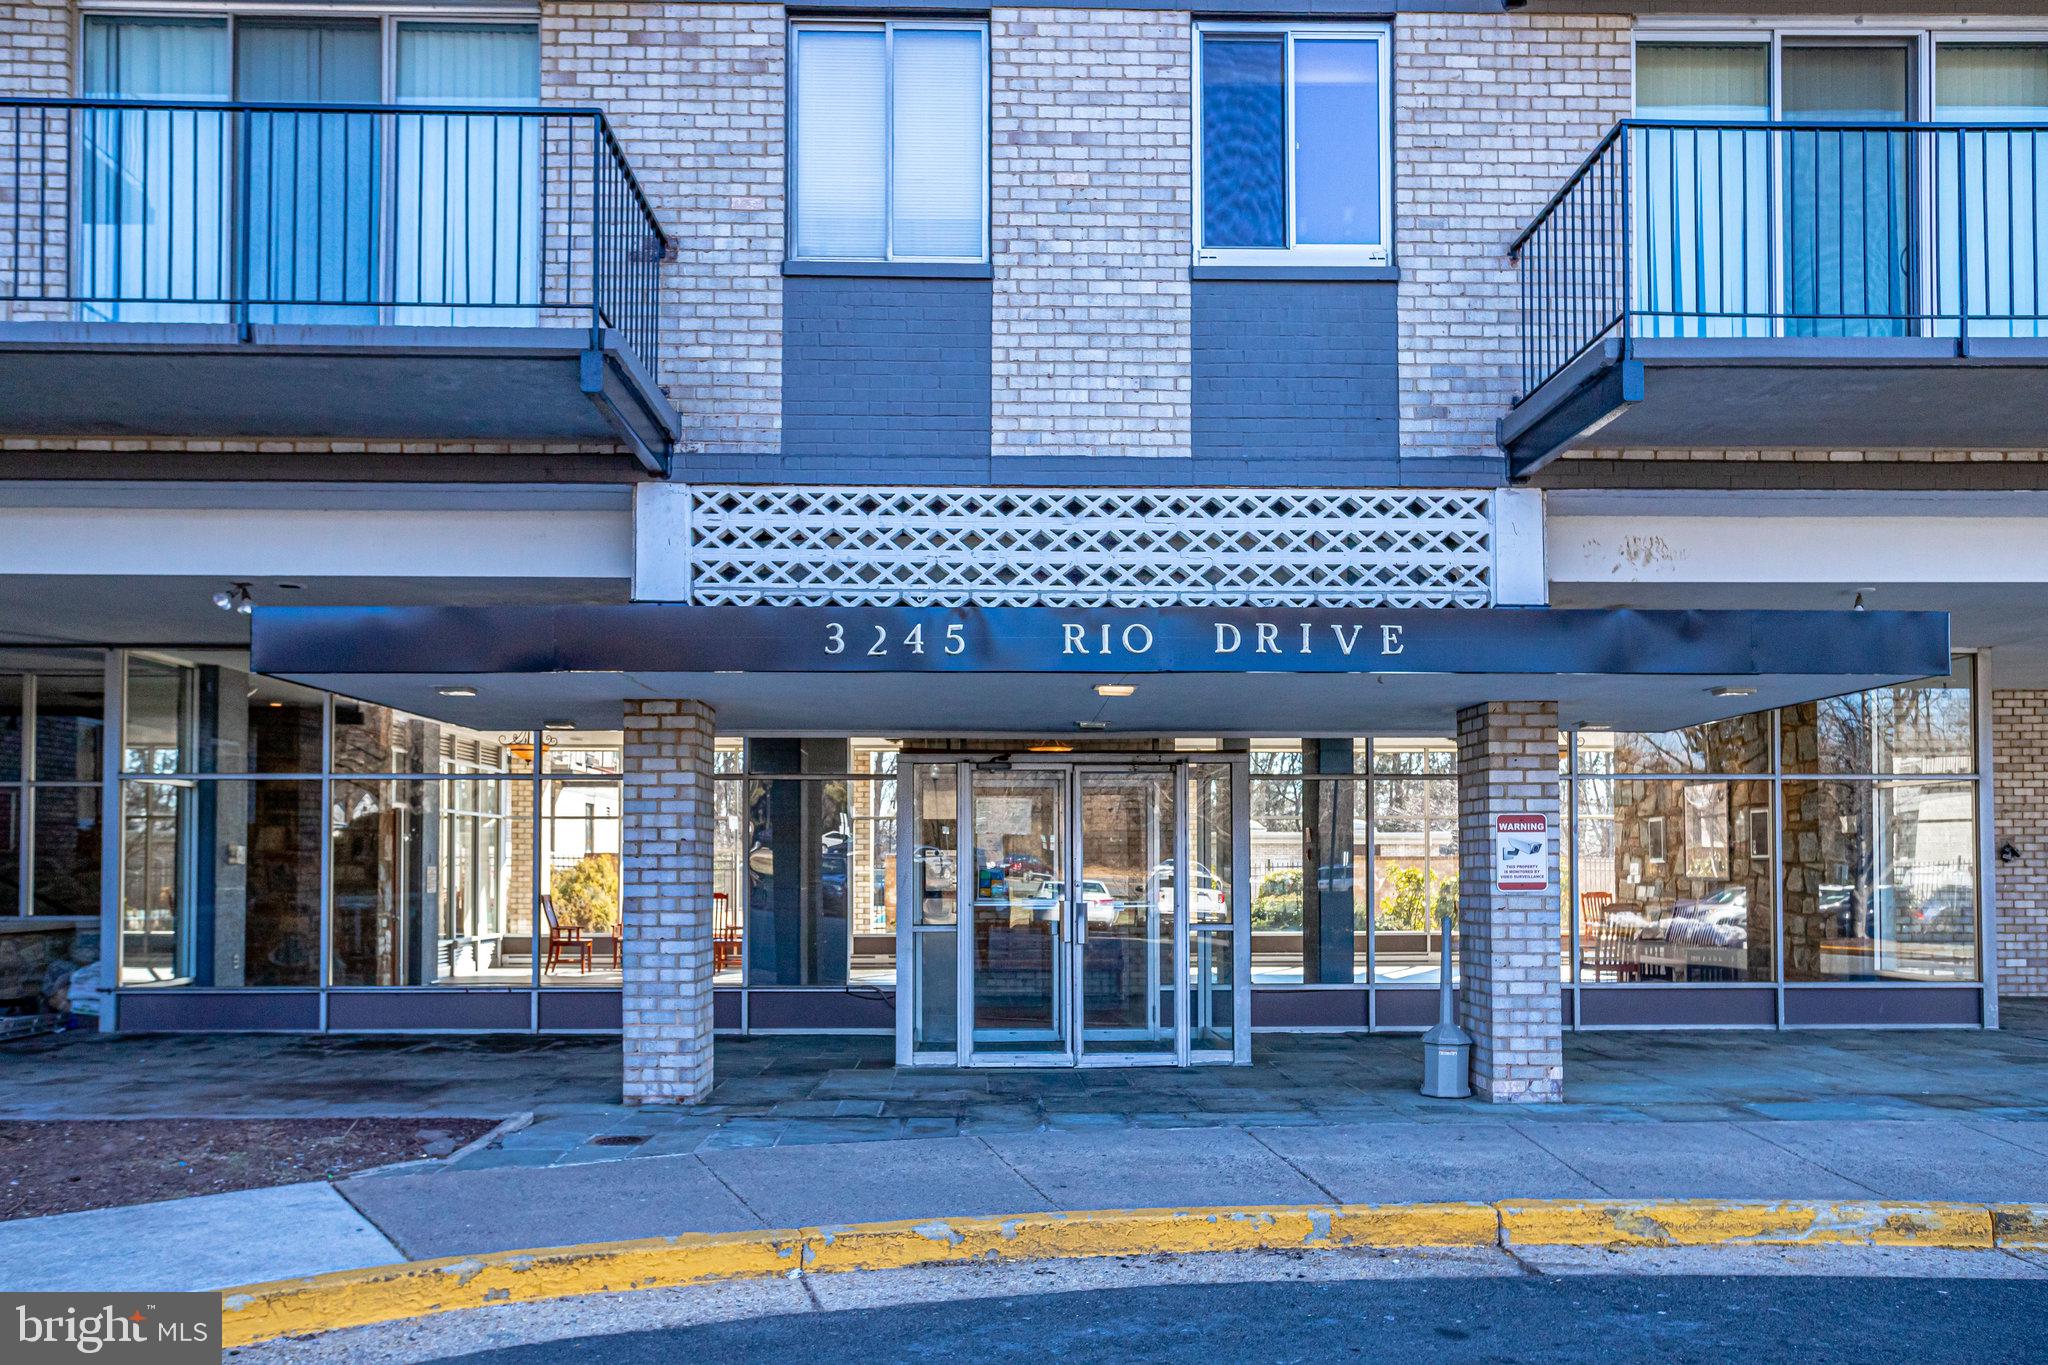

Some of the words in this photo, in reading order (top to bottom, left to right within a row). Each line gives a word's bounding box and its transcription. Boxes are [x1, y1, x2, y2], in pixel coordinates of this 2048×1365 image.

[824, 622, 966, 656] 3245
[1061, 623, 1154, 654] RIO
[1214, 622, 1404, 655] DRIVE
[1498, 822, 1545, 831] WARNING
